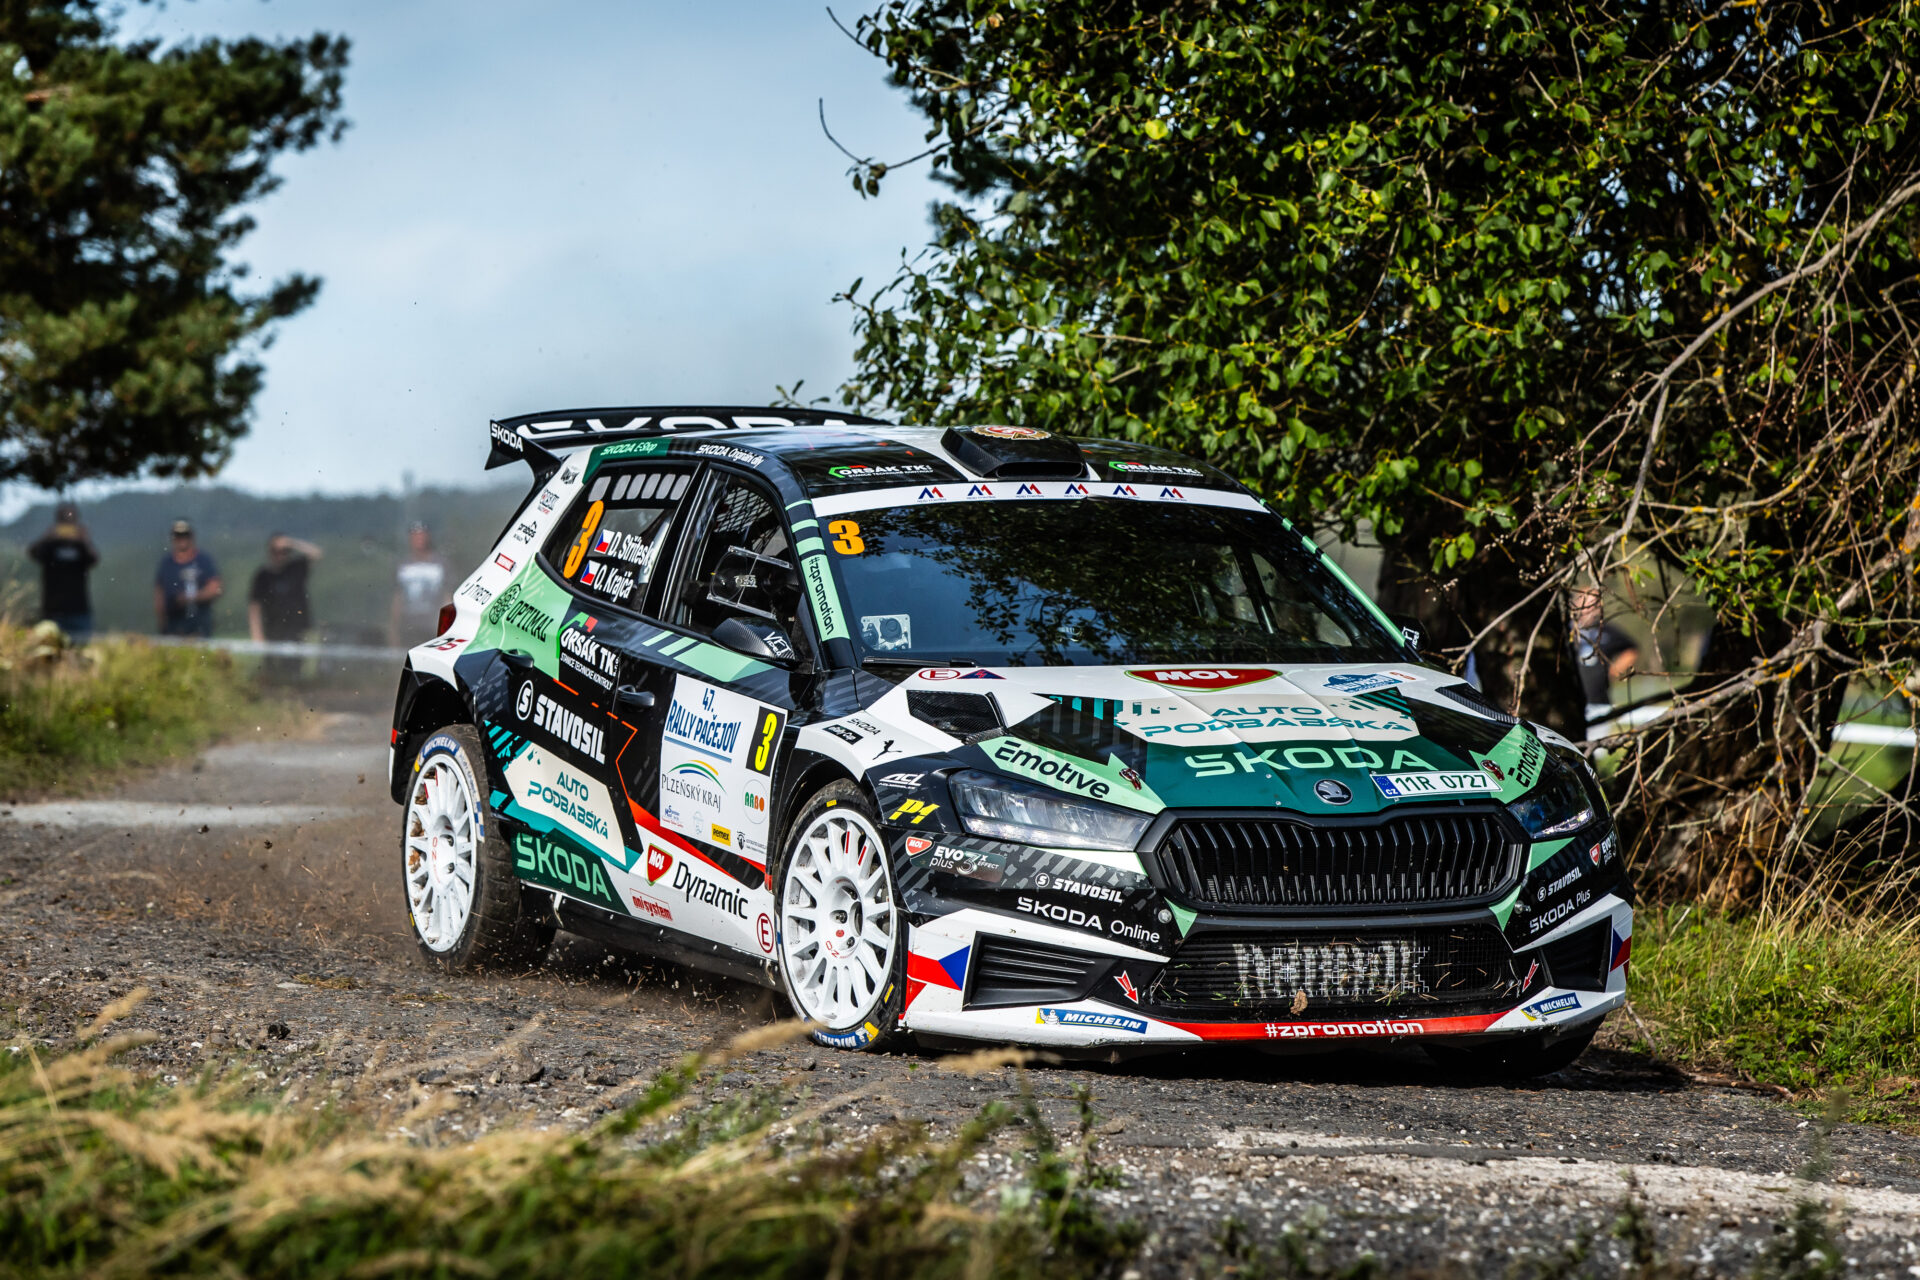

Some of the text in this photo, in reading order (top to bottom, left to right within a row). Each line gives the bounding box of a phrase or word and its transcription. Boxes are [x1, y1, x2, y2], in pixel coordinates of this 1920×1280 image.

[563, 500, 604, 579] 3
[607, 531, 622, 558] D.
[828, 520, 865, 555] 3
[593, 564, 608, 591] O.
[808, 556, 835, 636] #zpromotion
[506, 600, 554, 643] OPTIMAL
[560, 627, 600, 666] ORSÁK
[1154, 670, 1239, 681] MOL
[702, 687, 715, 713] 47.
[1210, 706, 1322, 717] AUTO
[533, 693, 606, 765] STAVOSIL
[665, 699, 742, 753] RALLY PAČEJOV
[423, 736, 457, 757] MICHELIN
[754, 712, 777, 772] 3
[994, 740, 1110, 799] Emotive
[1507, 734, 1541, 788] Emotive
[556, 771, 589, 802] AUTO
[661, 773, 702, 803] PLZEŇSKÝ
[702, 788, 722, 813] KRAJ
[1385, 788, 1399, 796] CZ
[1395, 774, 1488, 791] 11R 0727
[648, 849, 665, 871] MOL
[929, 856, 955, 869] plus
[933, 845, 965, 861] EVO
[977, 860, 1000, 870] EFFECT
[672, 861, 749, 920] Dynamic
[1052, 878, 1124, 905] STAVOSIL
[1547, 865, 1582, 897] STAVOSIL
[1576, 888, 1591, 908] Plus
[1110, 919, 1160, 944] Online
[1539, 996, 1576, 1014] MICHELIN
[1063, 1012, 1142, 1029] MICHELIN
[1265, 1019, 1425, 1038] #zpromotion
